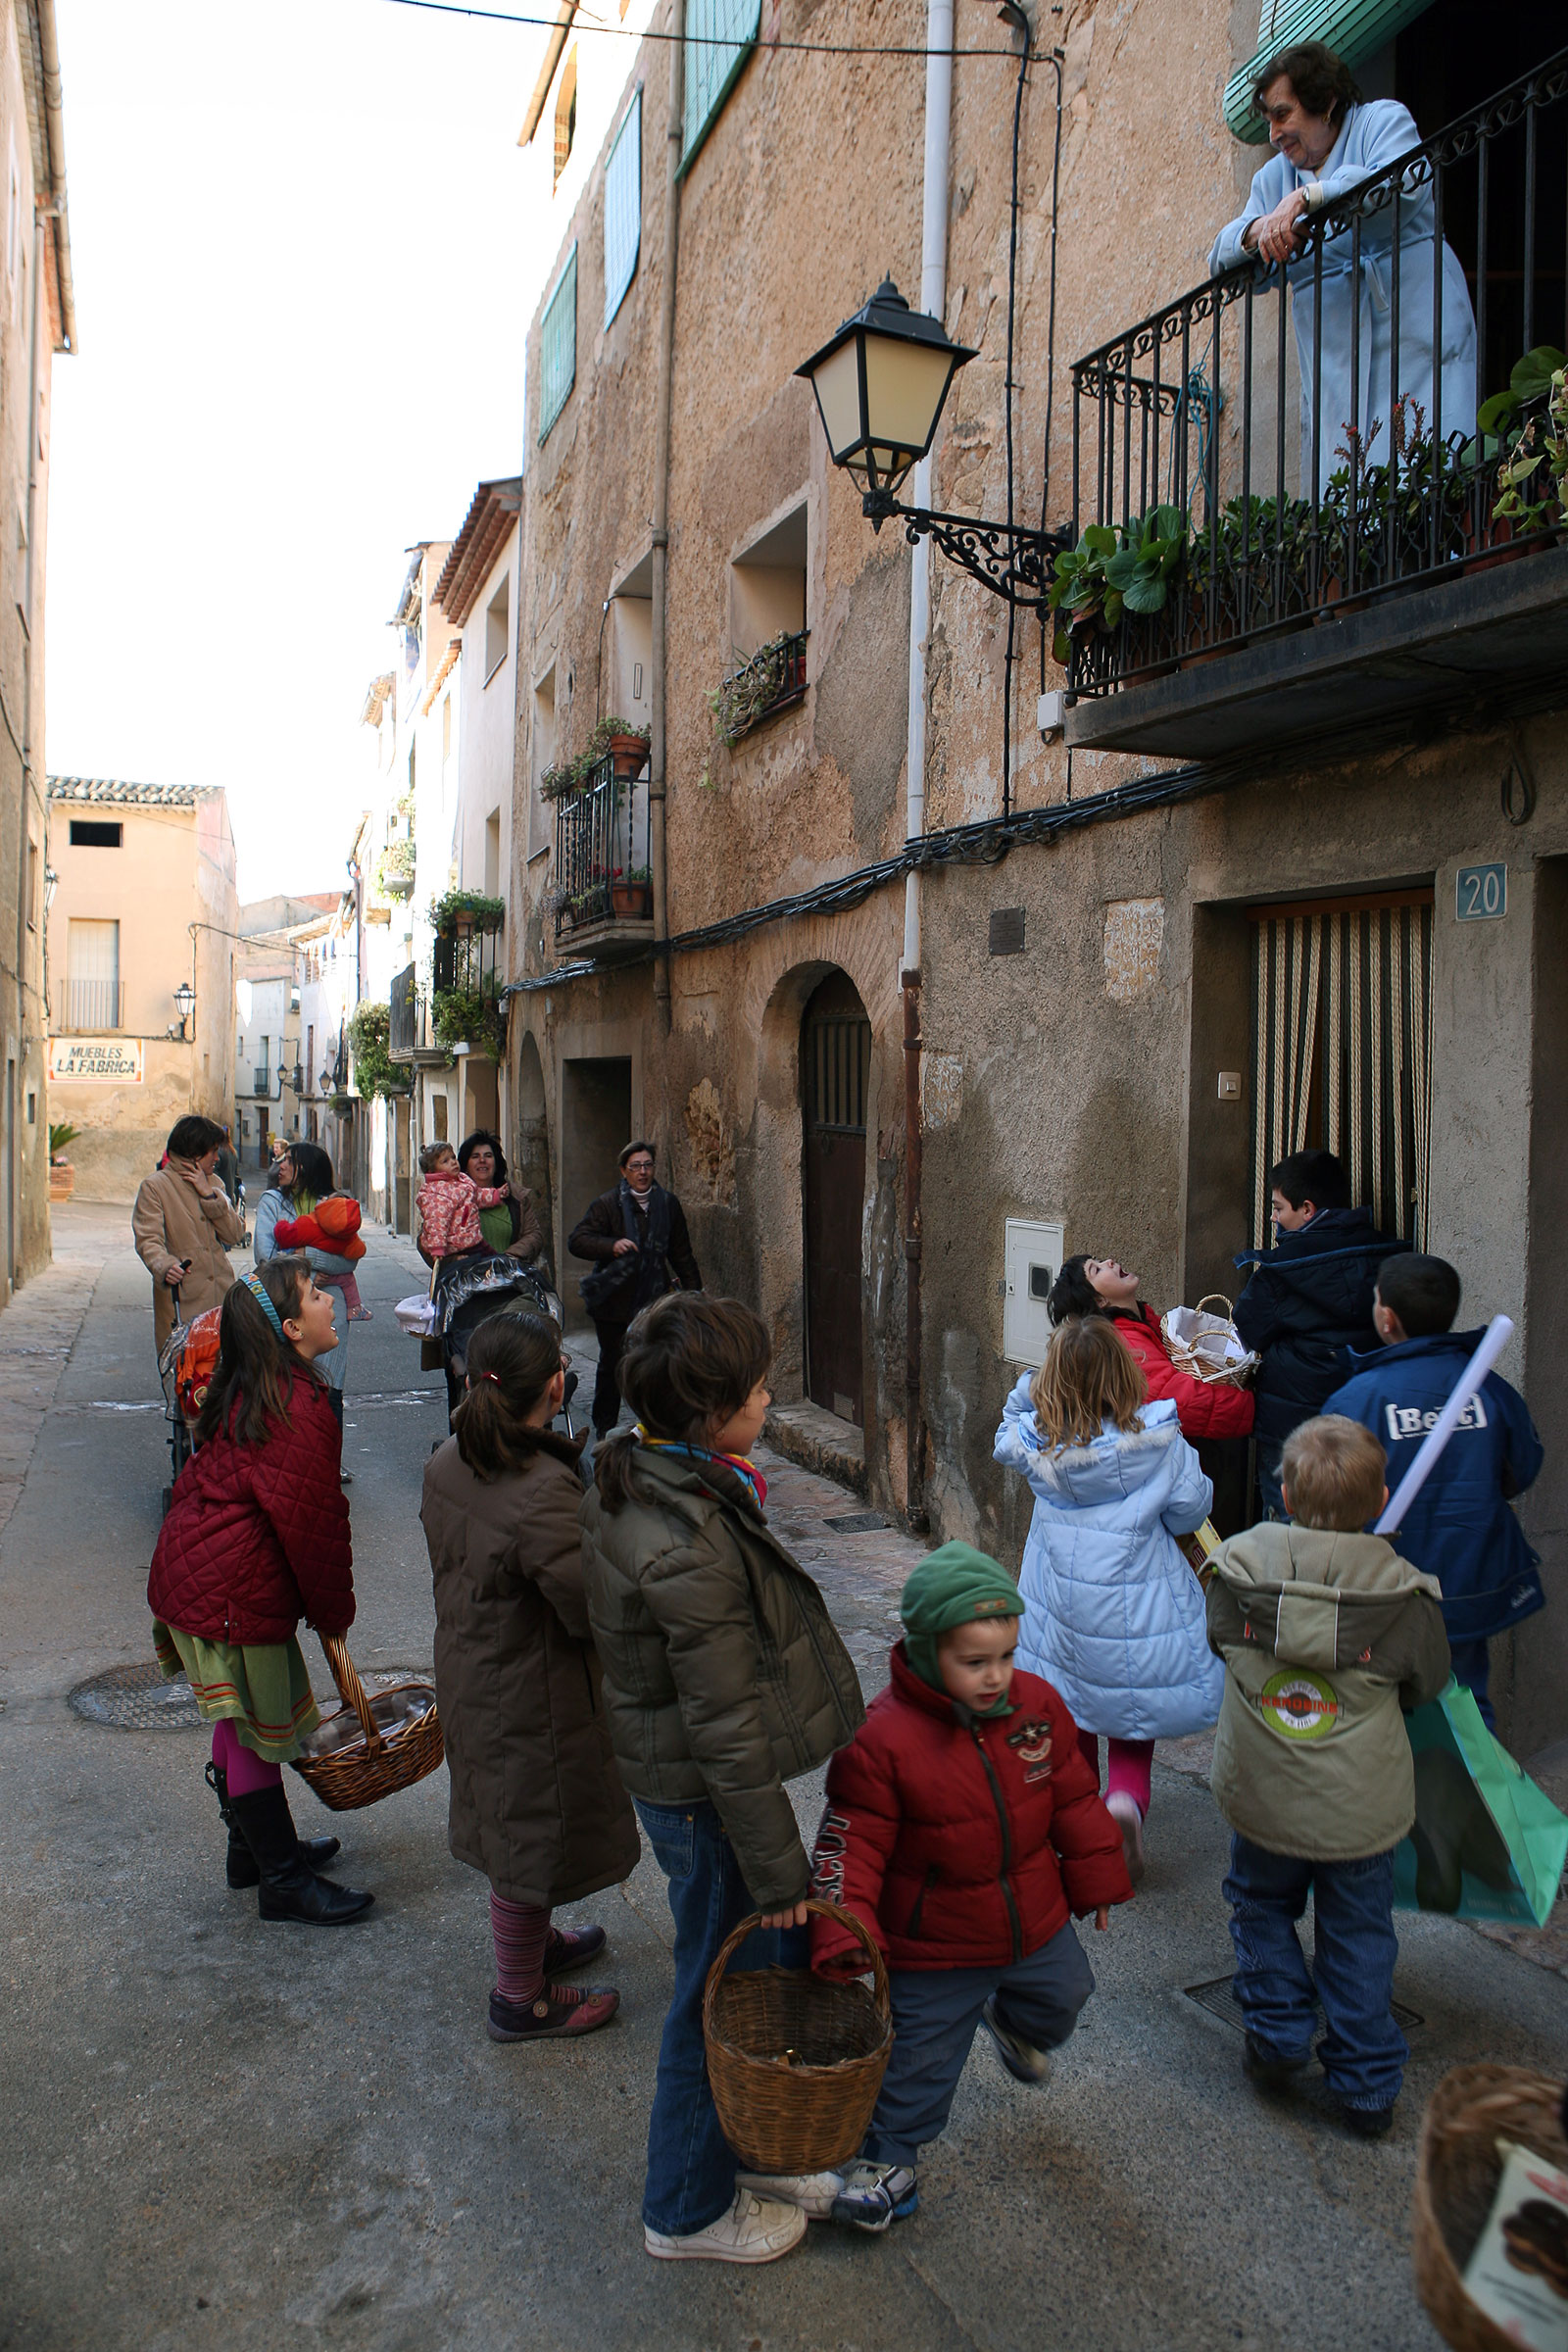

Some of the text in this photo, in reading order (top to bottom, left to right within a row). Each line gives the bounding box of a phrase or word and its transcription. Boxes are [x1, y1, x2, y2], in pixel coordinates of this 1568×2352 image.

[1464, 870, 1500, 915] 20
[69, 1046, 123, 1059] MUEBLES
[56, 1058, 135, 1074] LA FABRICA
